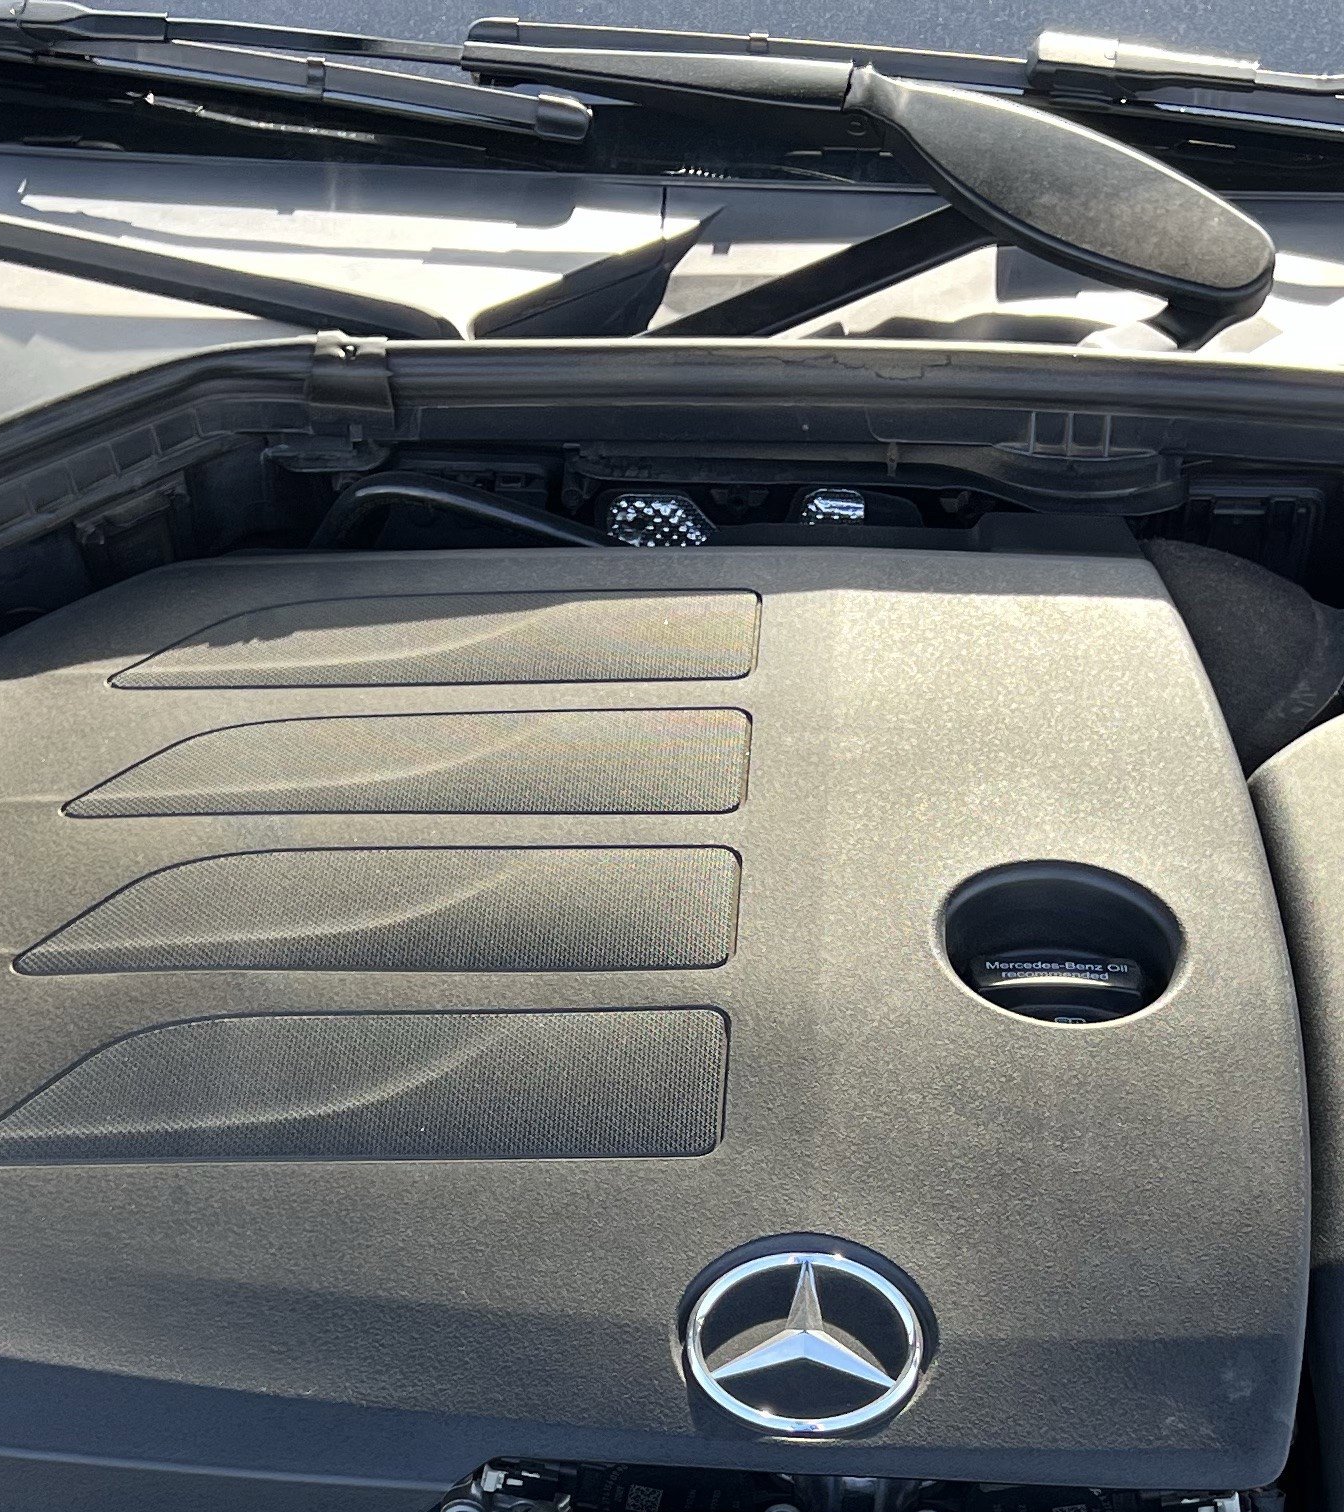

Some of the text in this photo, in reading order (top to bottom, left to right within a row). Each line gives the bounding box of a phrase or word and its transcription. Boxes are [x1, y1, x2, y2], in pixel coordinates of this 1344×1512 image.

[985, 960, 1129, 974] Mercedes-Benz Oil
[1001, 970, 1110, 981] recommended
